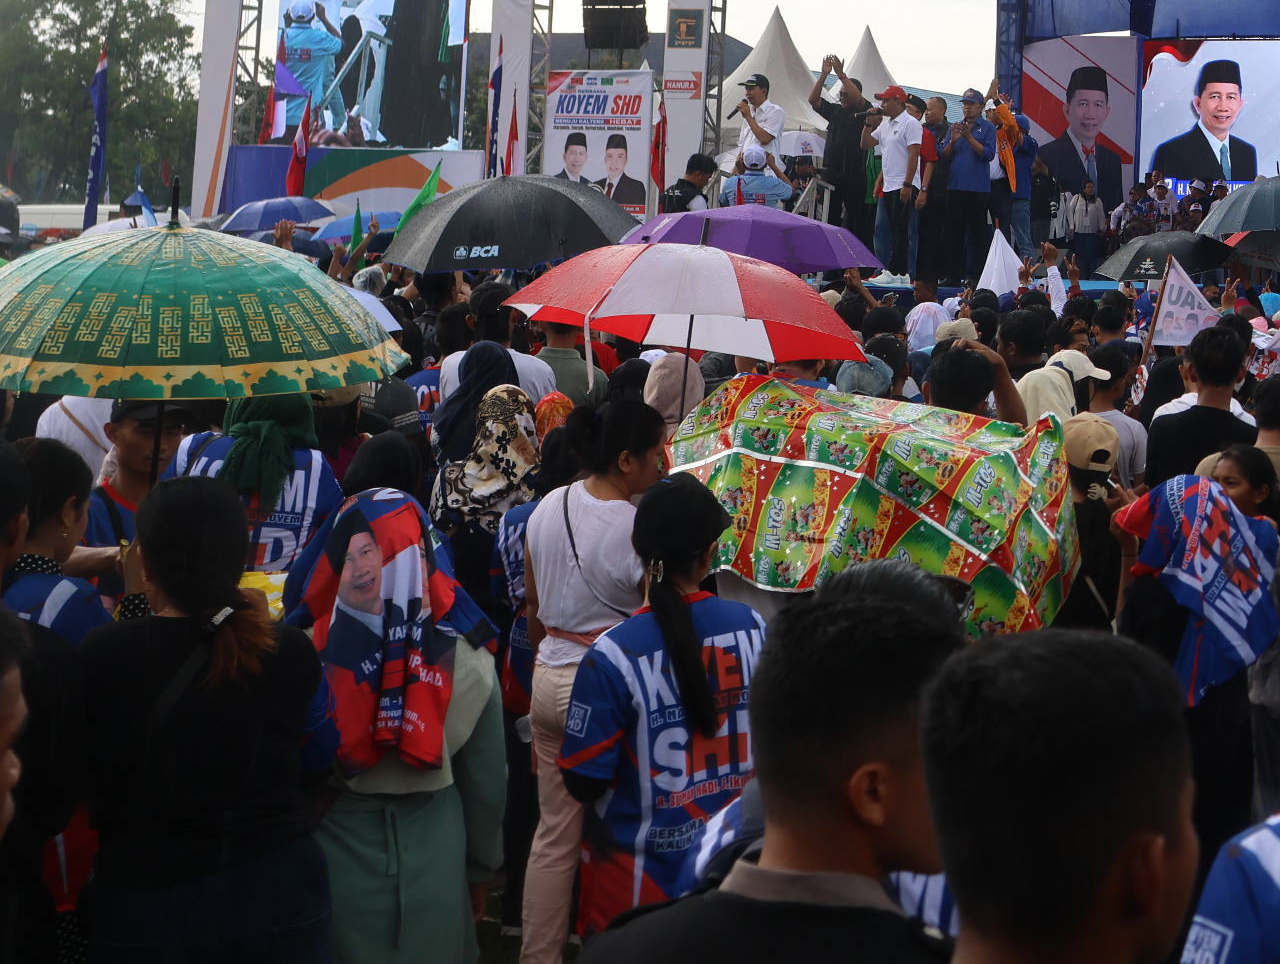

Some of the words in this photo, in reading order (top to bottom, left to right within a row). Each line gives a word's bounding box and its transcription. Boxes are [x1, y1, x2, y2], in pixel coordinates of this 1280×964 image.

[667, 81, 695, 90] HANURA
[555, 94, 609, 115] KOYEM
[611, 94, 642, 115] SHD
[470, 245, 499, 257] BCA
[742, 392, 769, 419] M-TOS
[965, 461, 997, 510] M-TOS
[764, 497, 786, 551] M-TOS
[829, 508, 852, 559] M-TOS
